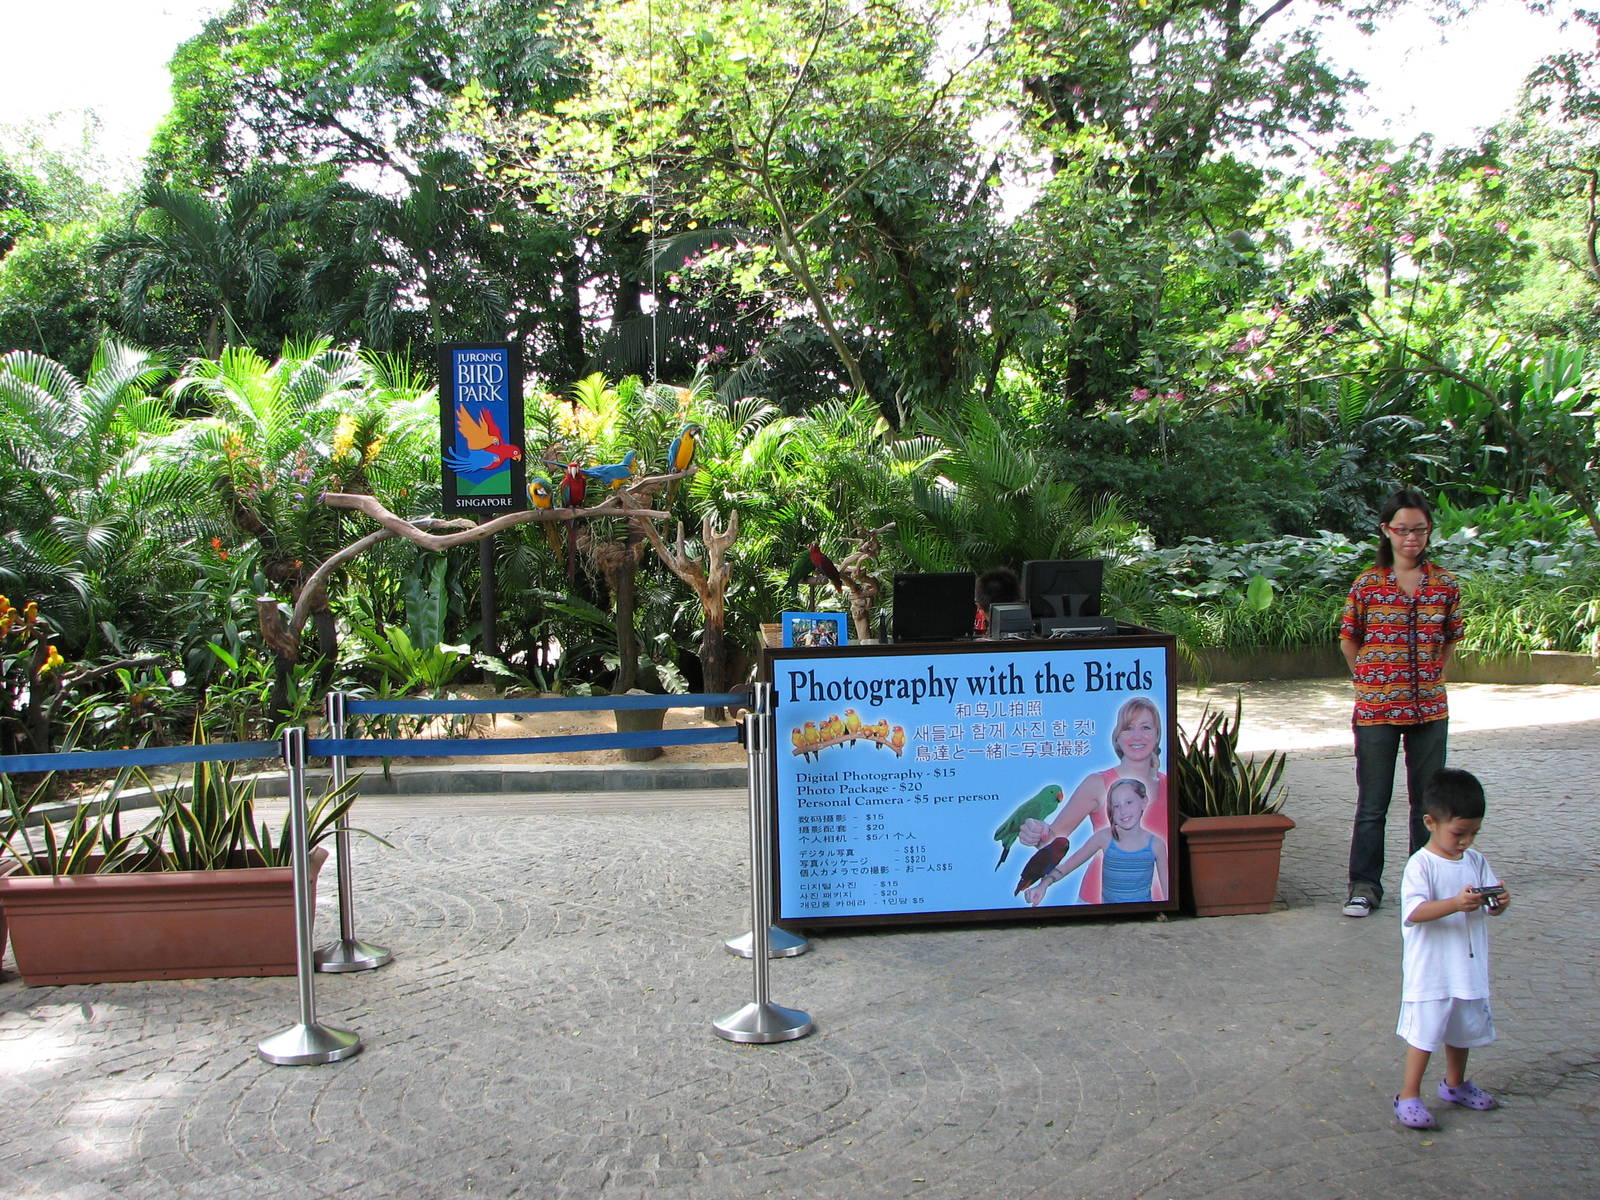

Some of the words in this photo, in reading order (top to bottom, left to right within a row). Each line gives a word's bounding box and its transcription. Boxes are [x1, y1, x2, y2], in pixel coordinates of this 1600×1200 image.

[458, 353, 502, 364] JURONG
[458, 364, 504, 386] BIRD
[458, 385, 504, 402] PARK
[456, 498, 512, 507] SINGAPORE
[788, 665, 959, 706] Photography
[966, 663, 1024, 696] with
[1034, 660, 1075, 693] the
[1084, 658, 1153, 692] Birds
[955, 701, 1042, 718] 和鸟儿拍照
[913, 724, 964, 742] 새들과
[972, 723, 1005, 740] 함께
[1012, 721, 1046, 738] 사진
[1052, 720, 1068, 737] 한
[916, 740, 1091, 761] 鳥達と一緒に写真撮影
[796, 772, 838, 784] Digital
[842, 769, 924, 781] Photography
[933, 768, 956, 778] $15
[797, 786, 836, 796] Photo
[839, 783, 889, 794] Package
[899, 782, 923, 792] $20
[797, 797, 851, 808] Personal
[855, 796, 904, 806] Camera
[914, 794, 929, 804] $5
[933, 796, 954, 805] per
[958, 793, 1000, 804] person
